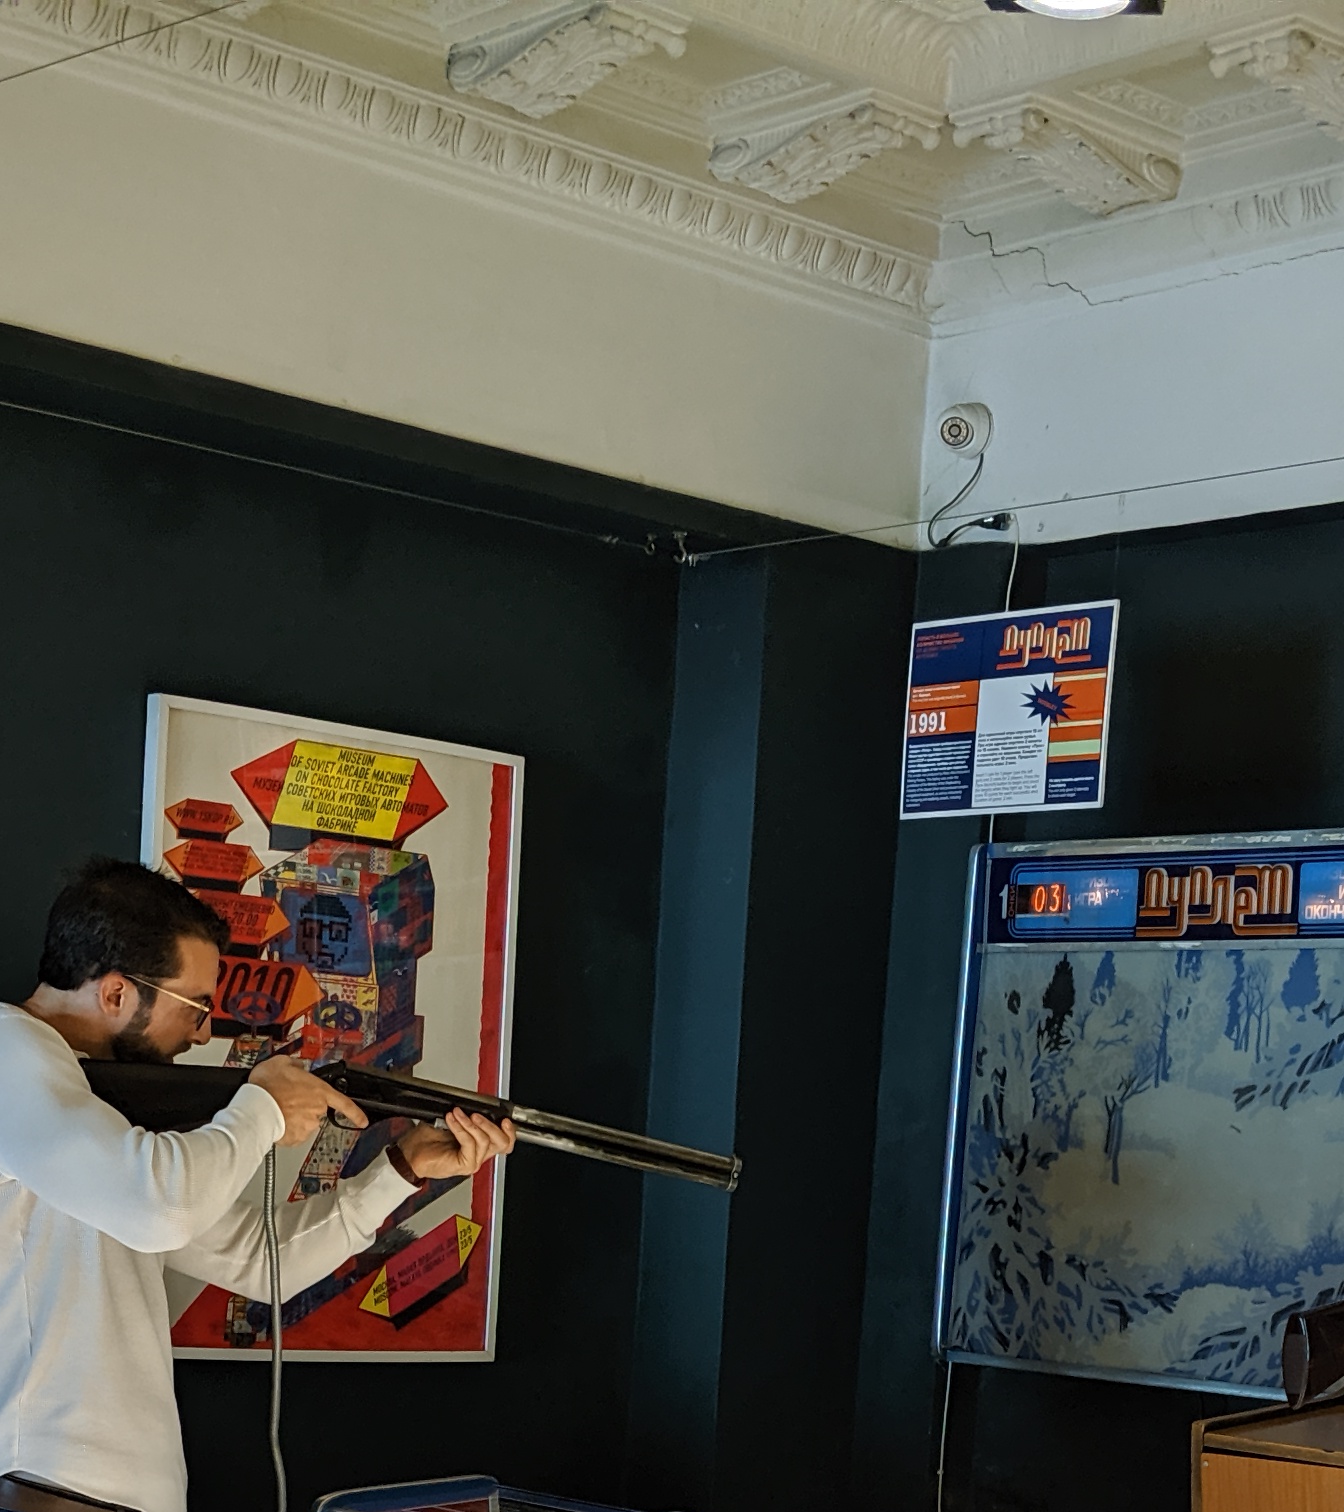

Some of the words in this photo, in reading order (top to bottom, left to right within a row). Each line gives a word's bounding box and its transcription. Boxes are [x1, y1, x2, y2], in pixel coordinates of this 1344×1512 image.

[909, 711, 946, 734] 1991
[338, 750, 376, 766] MUSEUM
[291, 755, 304, 767] OF
[305, 757, 336, 774] SOVIET
[336, 763, 371, 780] ARCADE
[372, 771, 414, 787] MACHINES
[295, 770, 308, 782] ON
[310, 773, 361, 791] CHOCOLATE
[361, 782, 400, 798] FACTORY
[286, 783, 336, 801] СОВЕТСКИХ
[339, 792, 379, 808] ИГРОВЫХ
[380, 800, 430, 816] АВТОМАТОВ
[302, 801, 314, 812] НА
[316, 803, 376, 822] ШОКОЛАДНОЙ
[316, 816, 358, 833] ФАБРИКЕ
[1074, 891, 1103, 906] ИГРА
